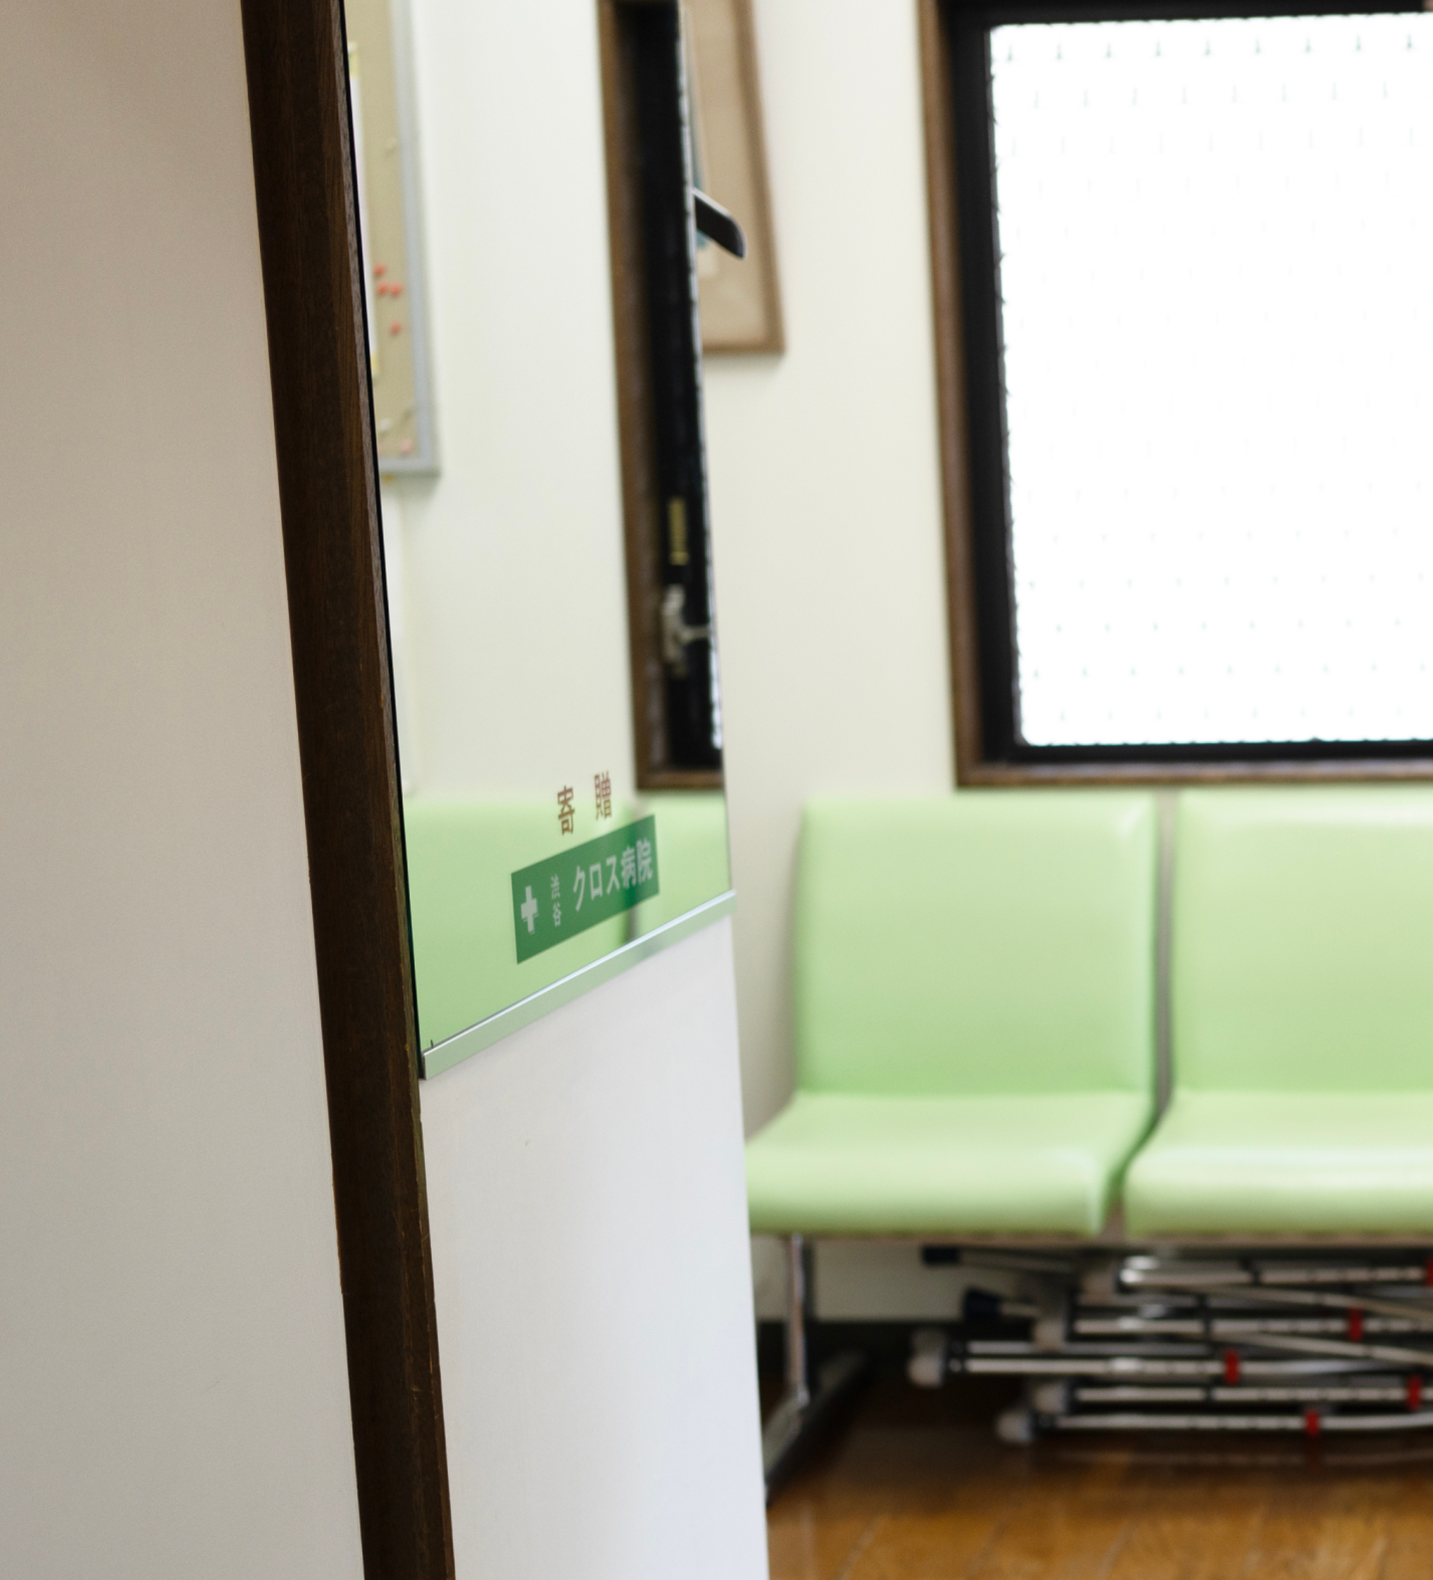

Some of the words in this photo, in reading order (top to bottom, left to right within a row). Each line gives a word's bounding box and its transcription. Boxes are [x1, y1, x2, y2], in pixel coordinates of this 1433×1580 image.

[573, 837, 653, 912] クロス病院
